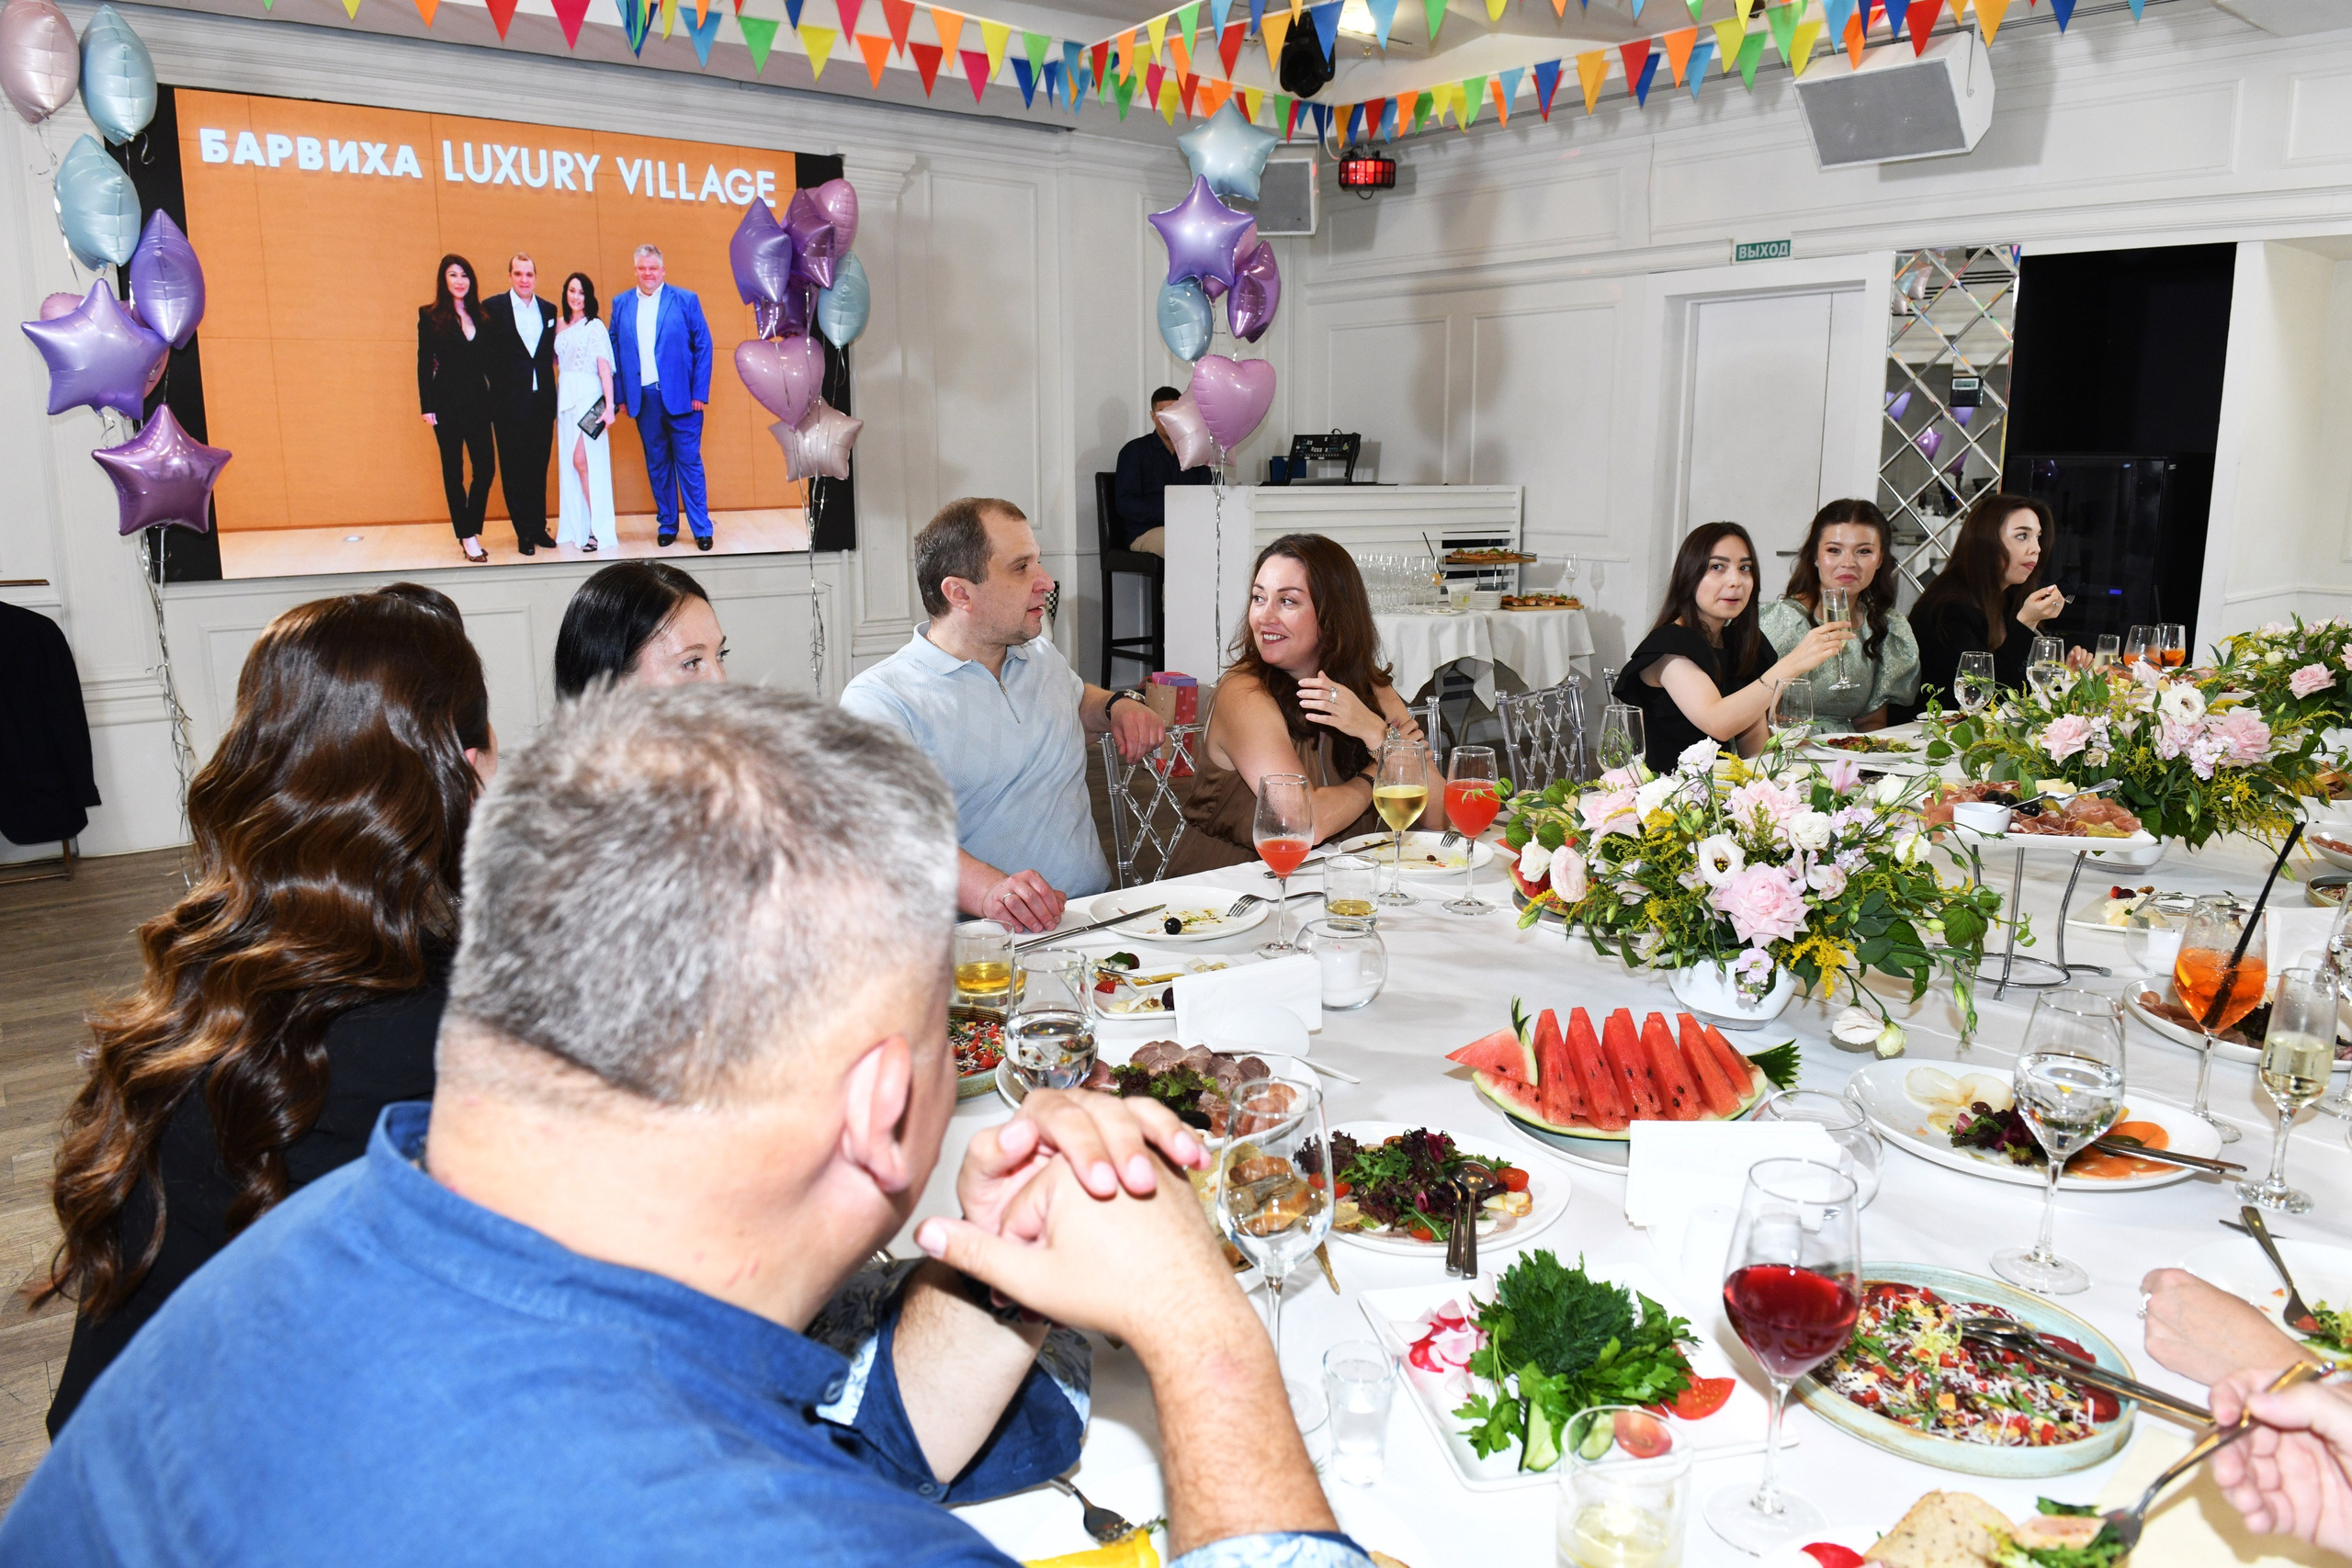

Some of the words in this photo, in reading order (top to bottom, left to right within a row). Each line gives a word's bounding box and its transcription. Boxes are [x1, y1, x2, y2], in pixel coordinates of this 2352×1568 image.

[198, 127, 423, 179] БАРВИХА
[442, 140, 601, 193] LUXURY
[616, 156, 776, 208] VILLAGE
[1738, 242, 1789, 259] ВЫХОД
